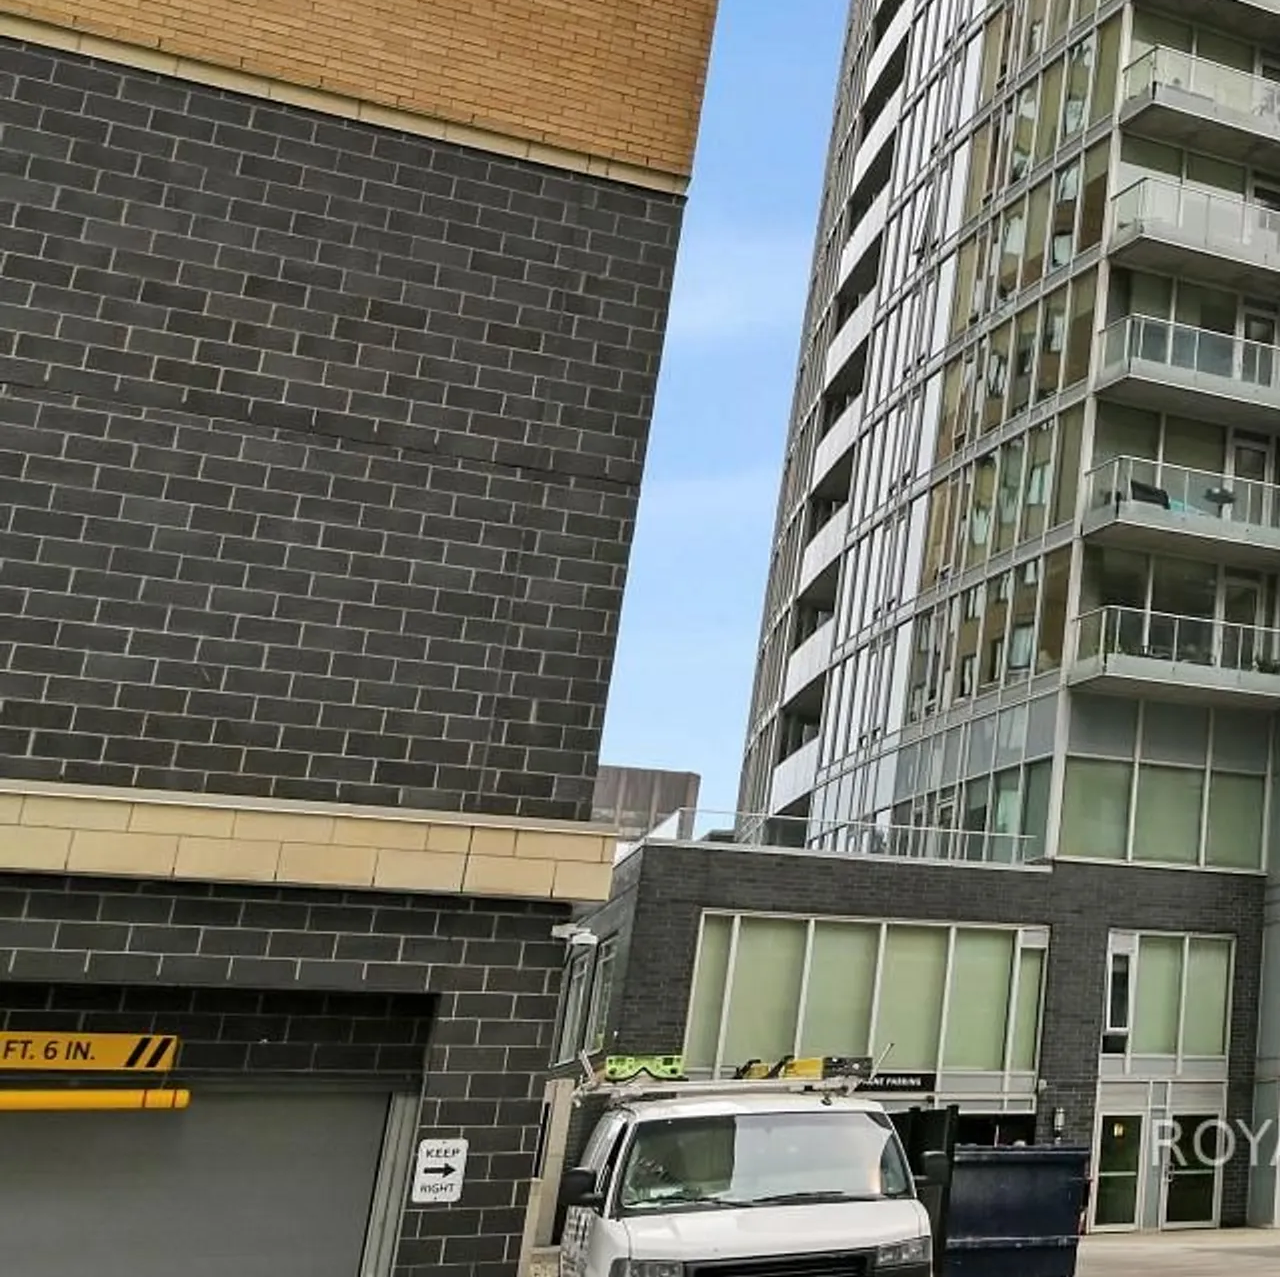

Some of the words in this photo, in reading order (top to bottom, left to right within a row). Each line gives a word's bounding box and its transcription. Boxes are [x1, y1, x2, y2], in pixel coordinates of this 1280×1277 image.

[3, 1039, 35, 1060] FT.
[44, 1040, 58, 1060] 6
[65, 1040, 95, 1060] IN.
[426, 1147, 460, 1158] KEEP
[420, 1183, 455, 1194] RIGHT
